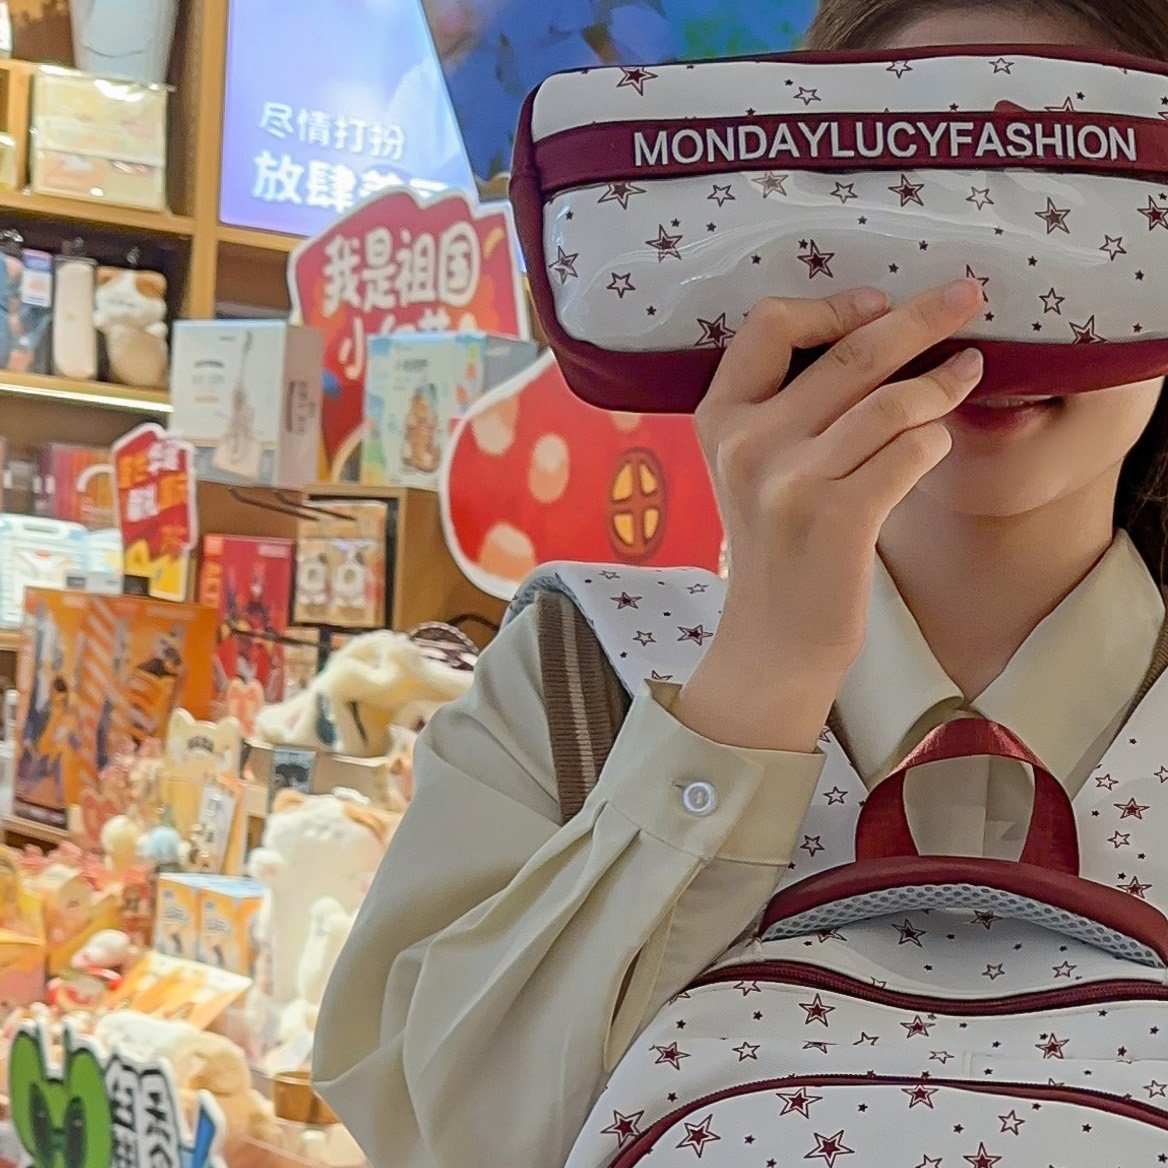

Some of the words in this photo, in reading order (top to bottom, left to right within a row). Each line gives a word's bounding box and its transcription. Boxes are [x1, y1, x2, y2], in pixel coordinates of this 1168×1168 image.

[259, 100, 406, 161] 尽情打扮
[633, 121, 1138, 167] MONDAYLUCYFASHION
[252, 150, 449, 213] 放肆
[322, 220, 482, 319] 我是祖国
